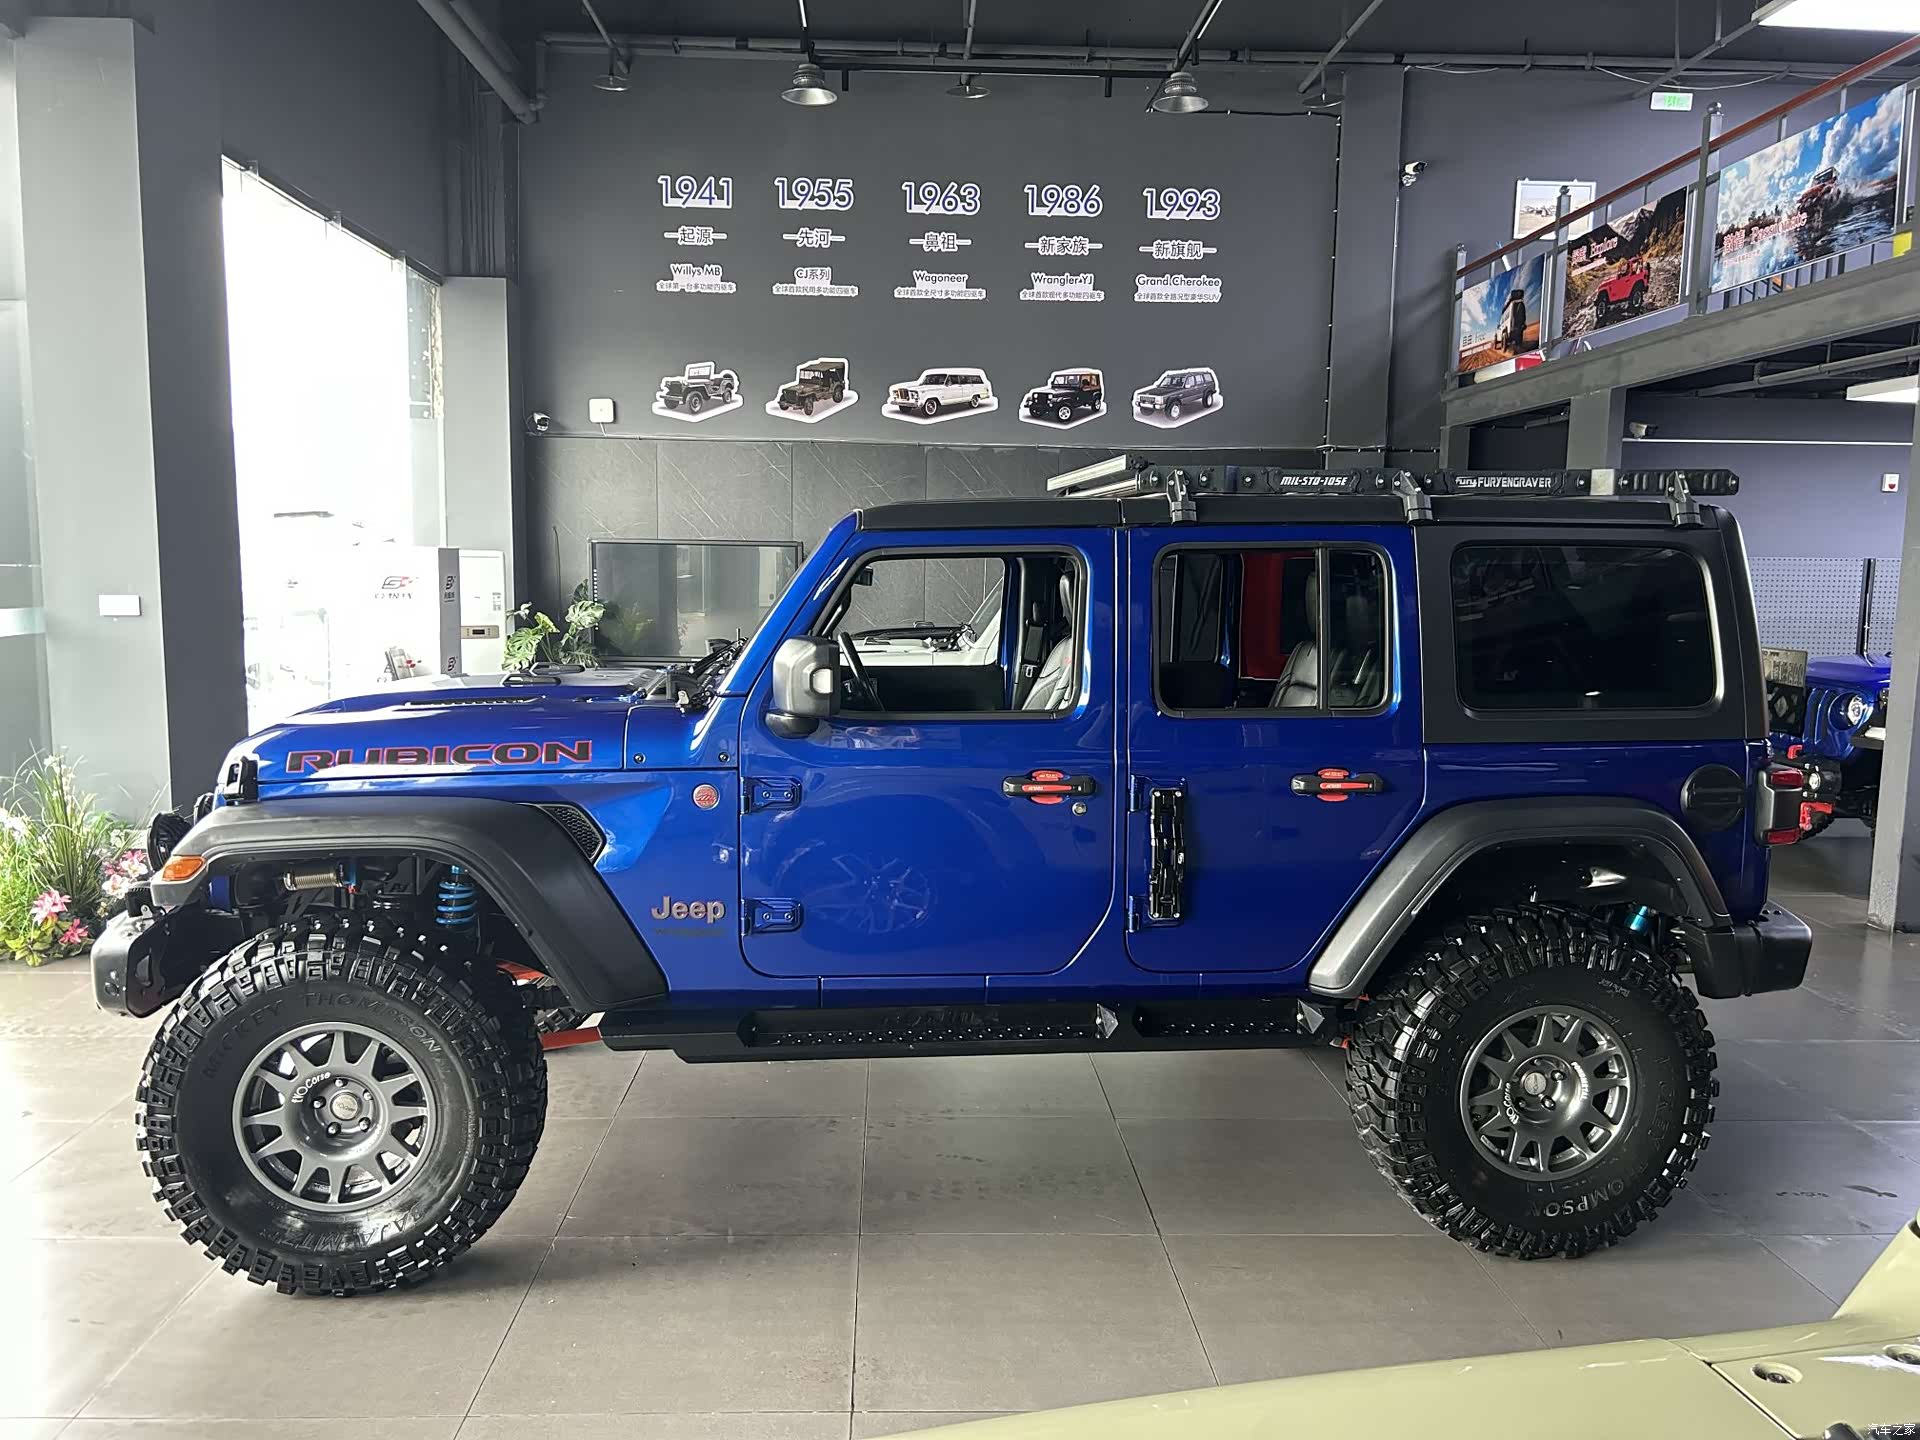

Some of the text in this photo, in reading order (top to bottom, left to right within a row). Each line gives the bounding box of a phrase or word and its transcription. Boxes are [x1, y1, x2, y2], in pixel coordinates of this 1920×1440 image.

[658, 176, 733, 209] 1941
[774, 177, 854, 211] 1955
[902, 182, 981, 215] 1963
[1024, 184, 1103, 216] 1986
[1143, 188, 1220, 220] 1993
[678, 226, 714, 246] 起源
[797, 228, 832, 248] 先河
[923, 232, 958, 252] 鼻祖
[1038, 236, 1090, 256] 新家族
[1153, 240, 1203, 260] 新旗舰
[671, 264, 721, 278] Willys MB
[795, 268, 832, 281] CJ系列
[914, 271, 967, 284] Wagoneer
[1032, 273, 1094, 286] Wrangler YJ
[1136, 275, 1222, 288] Grand Cherokee
[1477, 476, 1551, 488] FURYENGRAVER
[285, 740, 592, 773] RUBICON
[651, 896, 726, 924] Jeep
